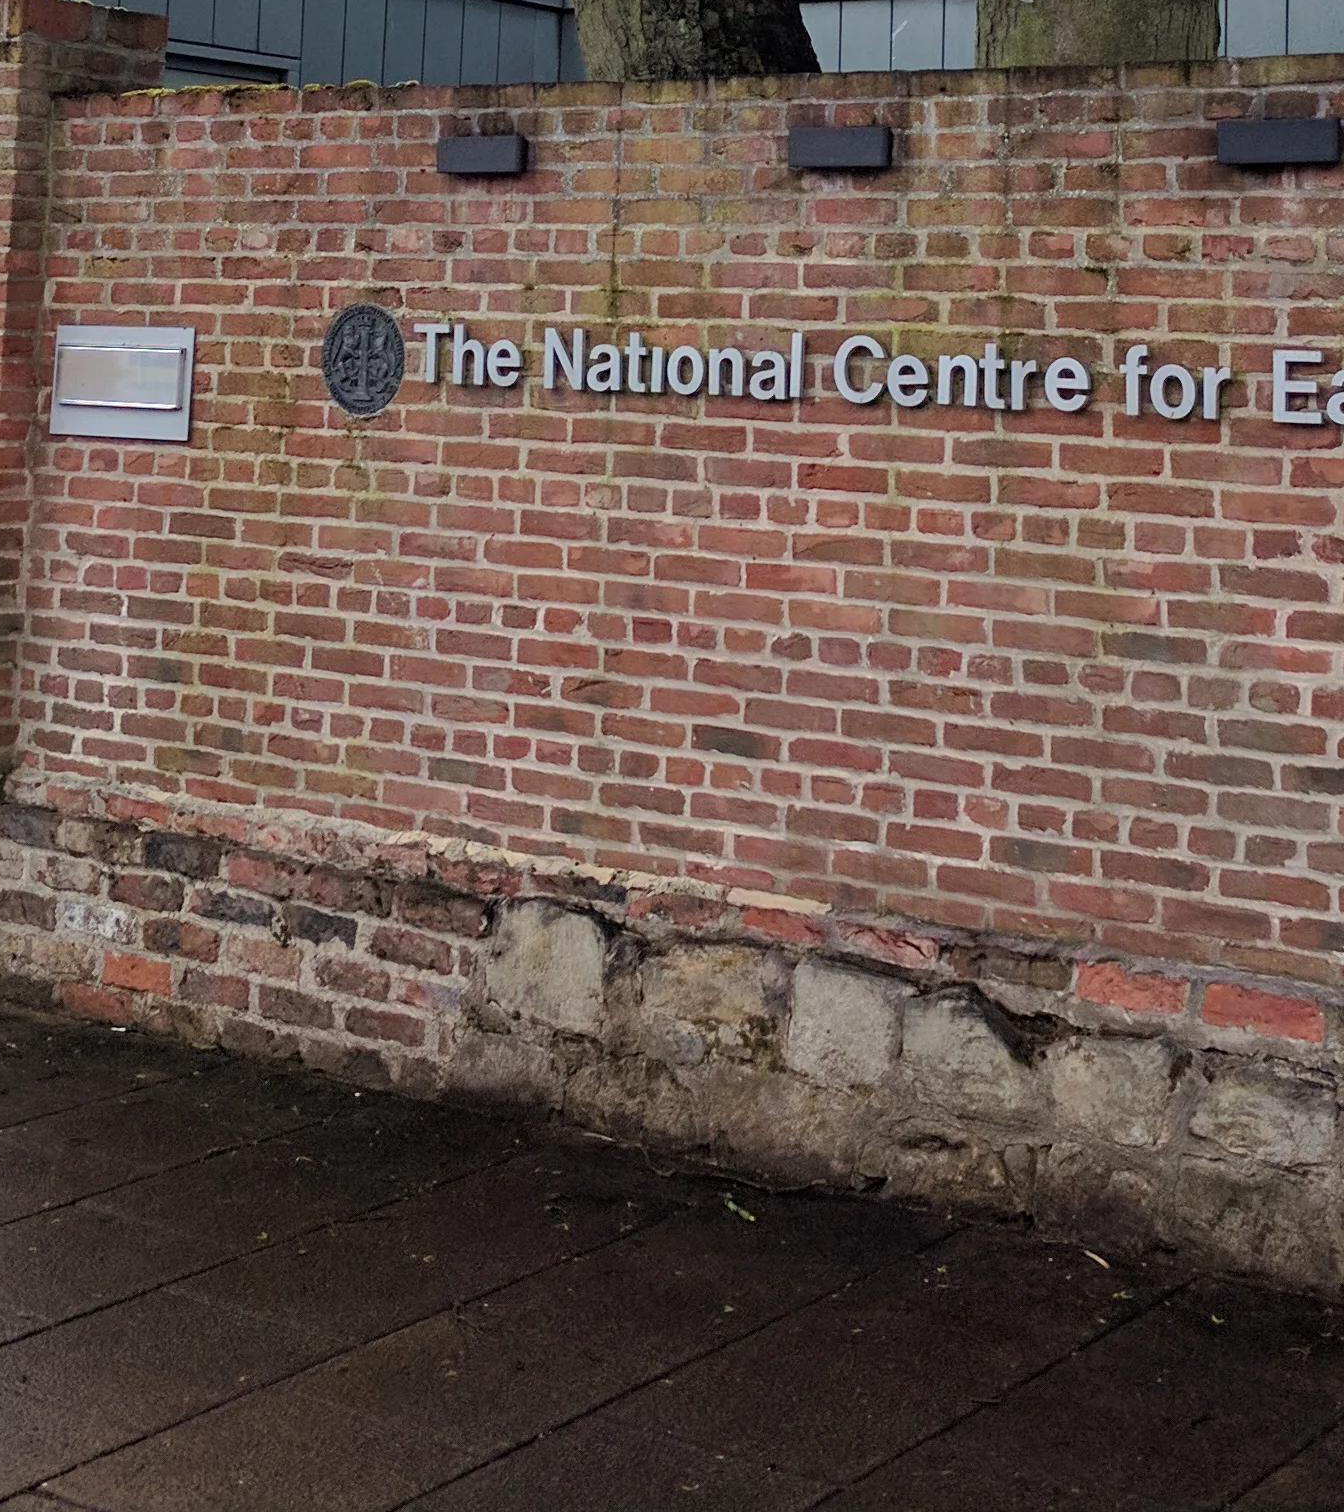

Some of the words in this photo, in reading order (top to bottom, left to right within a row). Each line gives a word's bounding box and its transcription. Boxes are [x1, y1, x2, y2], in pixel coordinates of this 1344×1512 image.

[413, 323, 523, 387] The
[543, 327, 804, 401] National
[833, 334, 1092, 413] Centre
[1120, 344, 1231, 421] for
